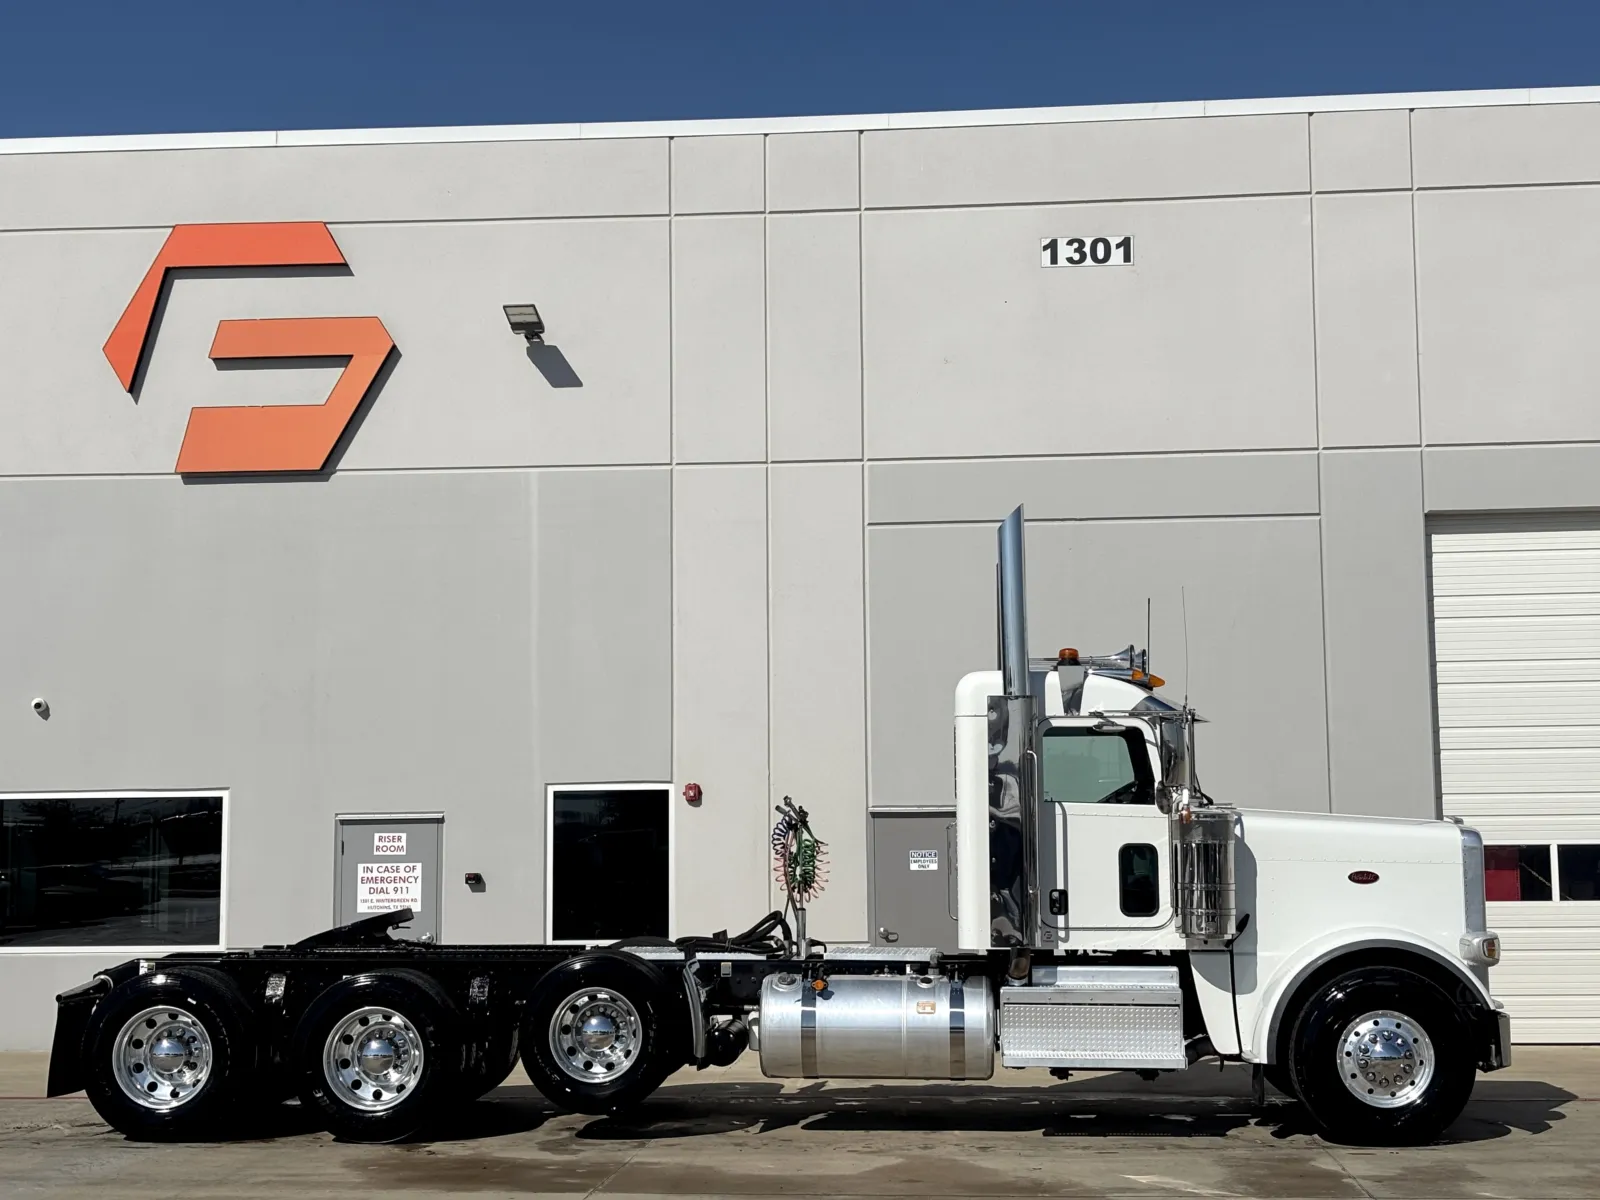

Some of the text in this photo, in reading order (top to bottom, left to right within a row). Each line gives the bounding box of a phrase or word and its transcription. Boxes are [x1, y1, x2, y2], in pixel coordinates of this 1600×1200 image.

[1042, 236, 1132, 265] 1301
[376, 866, 400, 874] CASE
[404, 865, 417, 873] OF
[360, 876, 419, 884] EMERGENCY
[393, 886, 409, 894] 911
